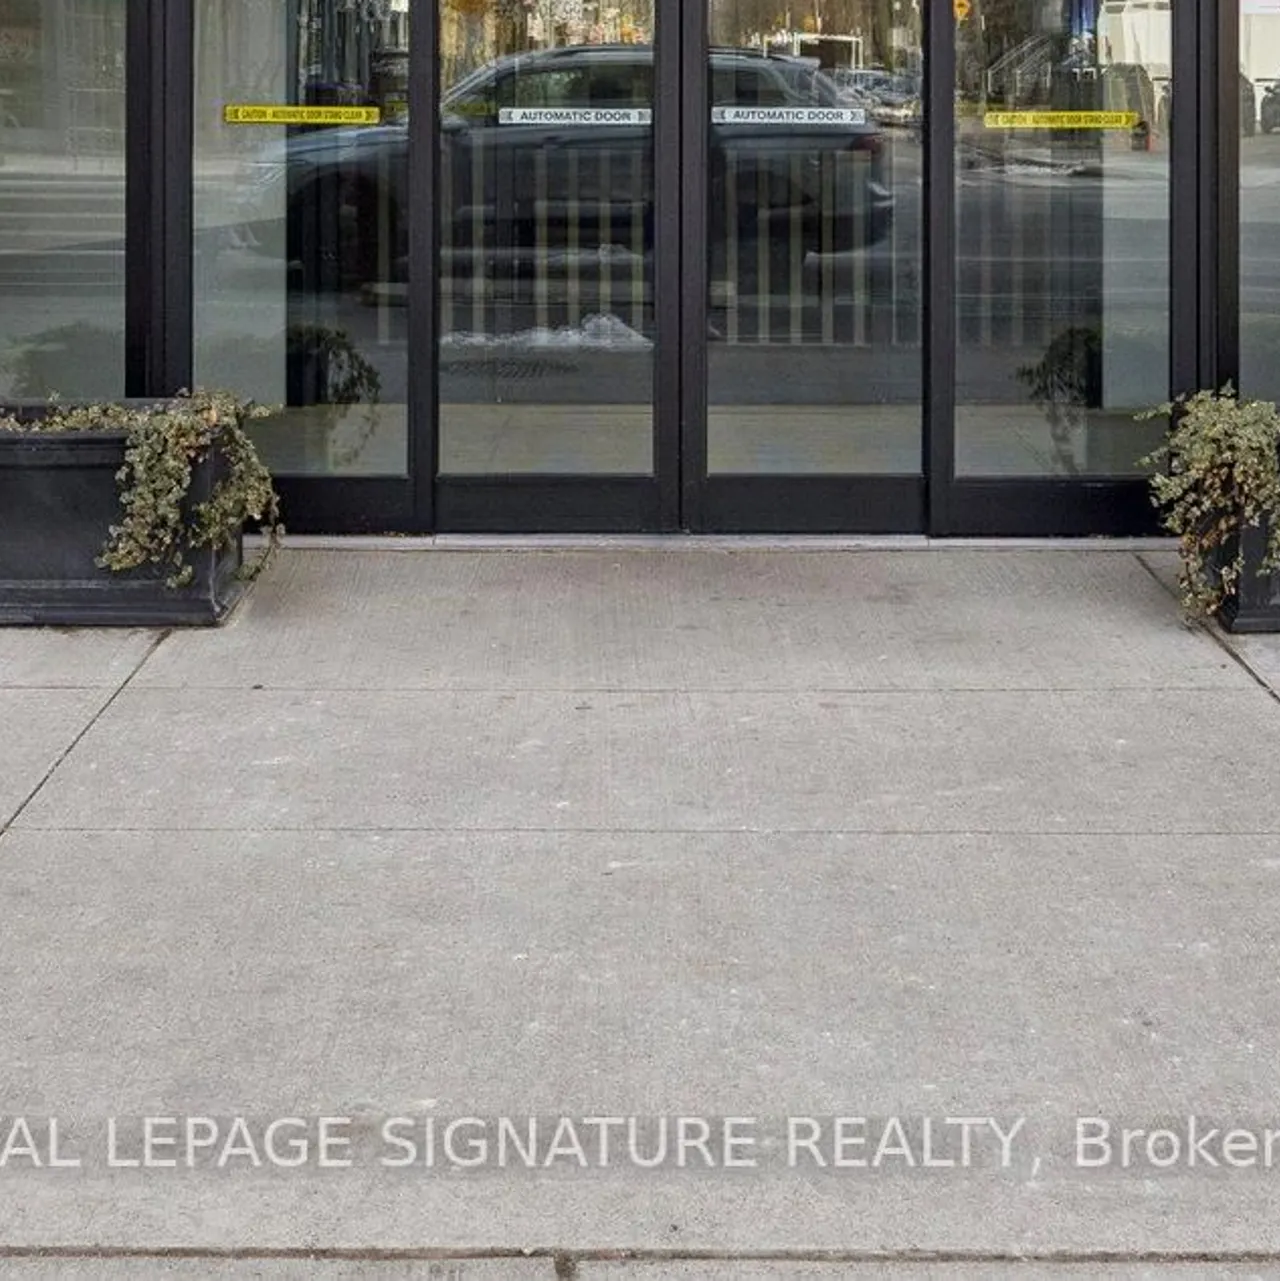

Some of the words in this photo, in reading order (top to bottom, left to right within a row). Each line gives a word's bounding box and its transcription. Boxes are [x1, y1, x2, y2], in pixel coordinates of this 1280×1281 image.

[520, 110, 592, 121] AUTOMATIC
[595, 110, 632, 121] DOOR
[733, 110, 804, 121] AUTOMATIC
[807, 110, 844, 121] DOOR
